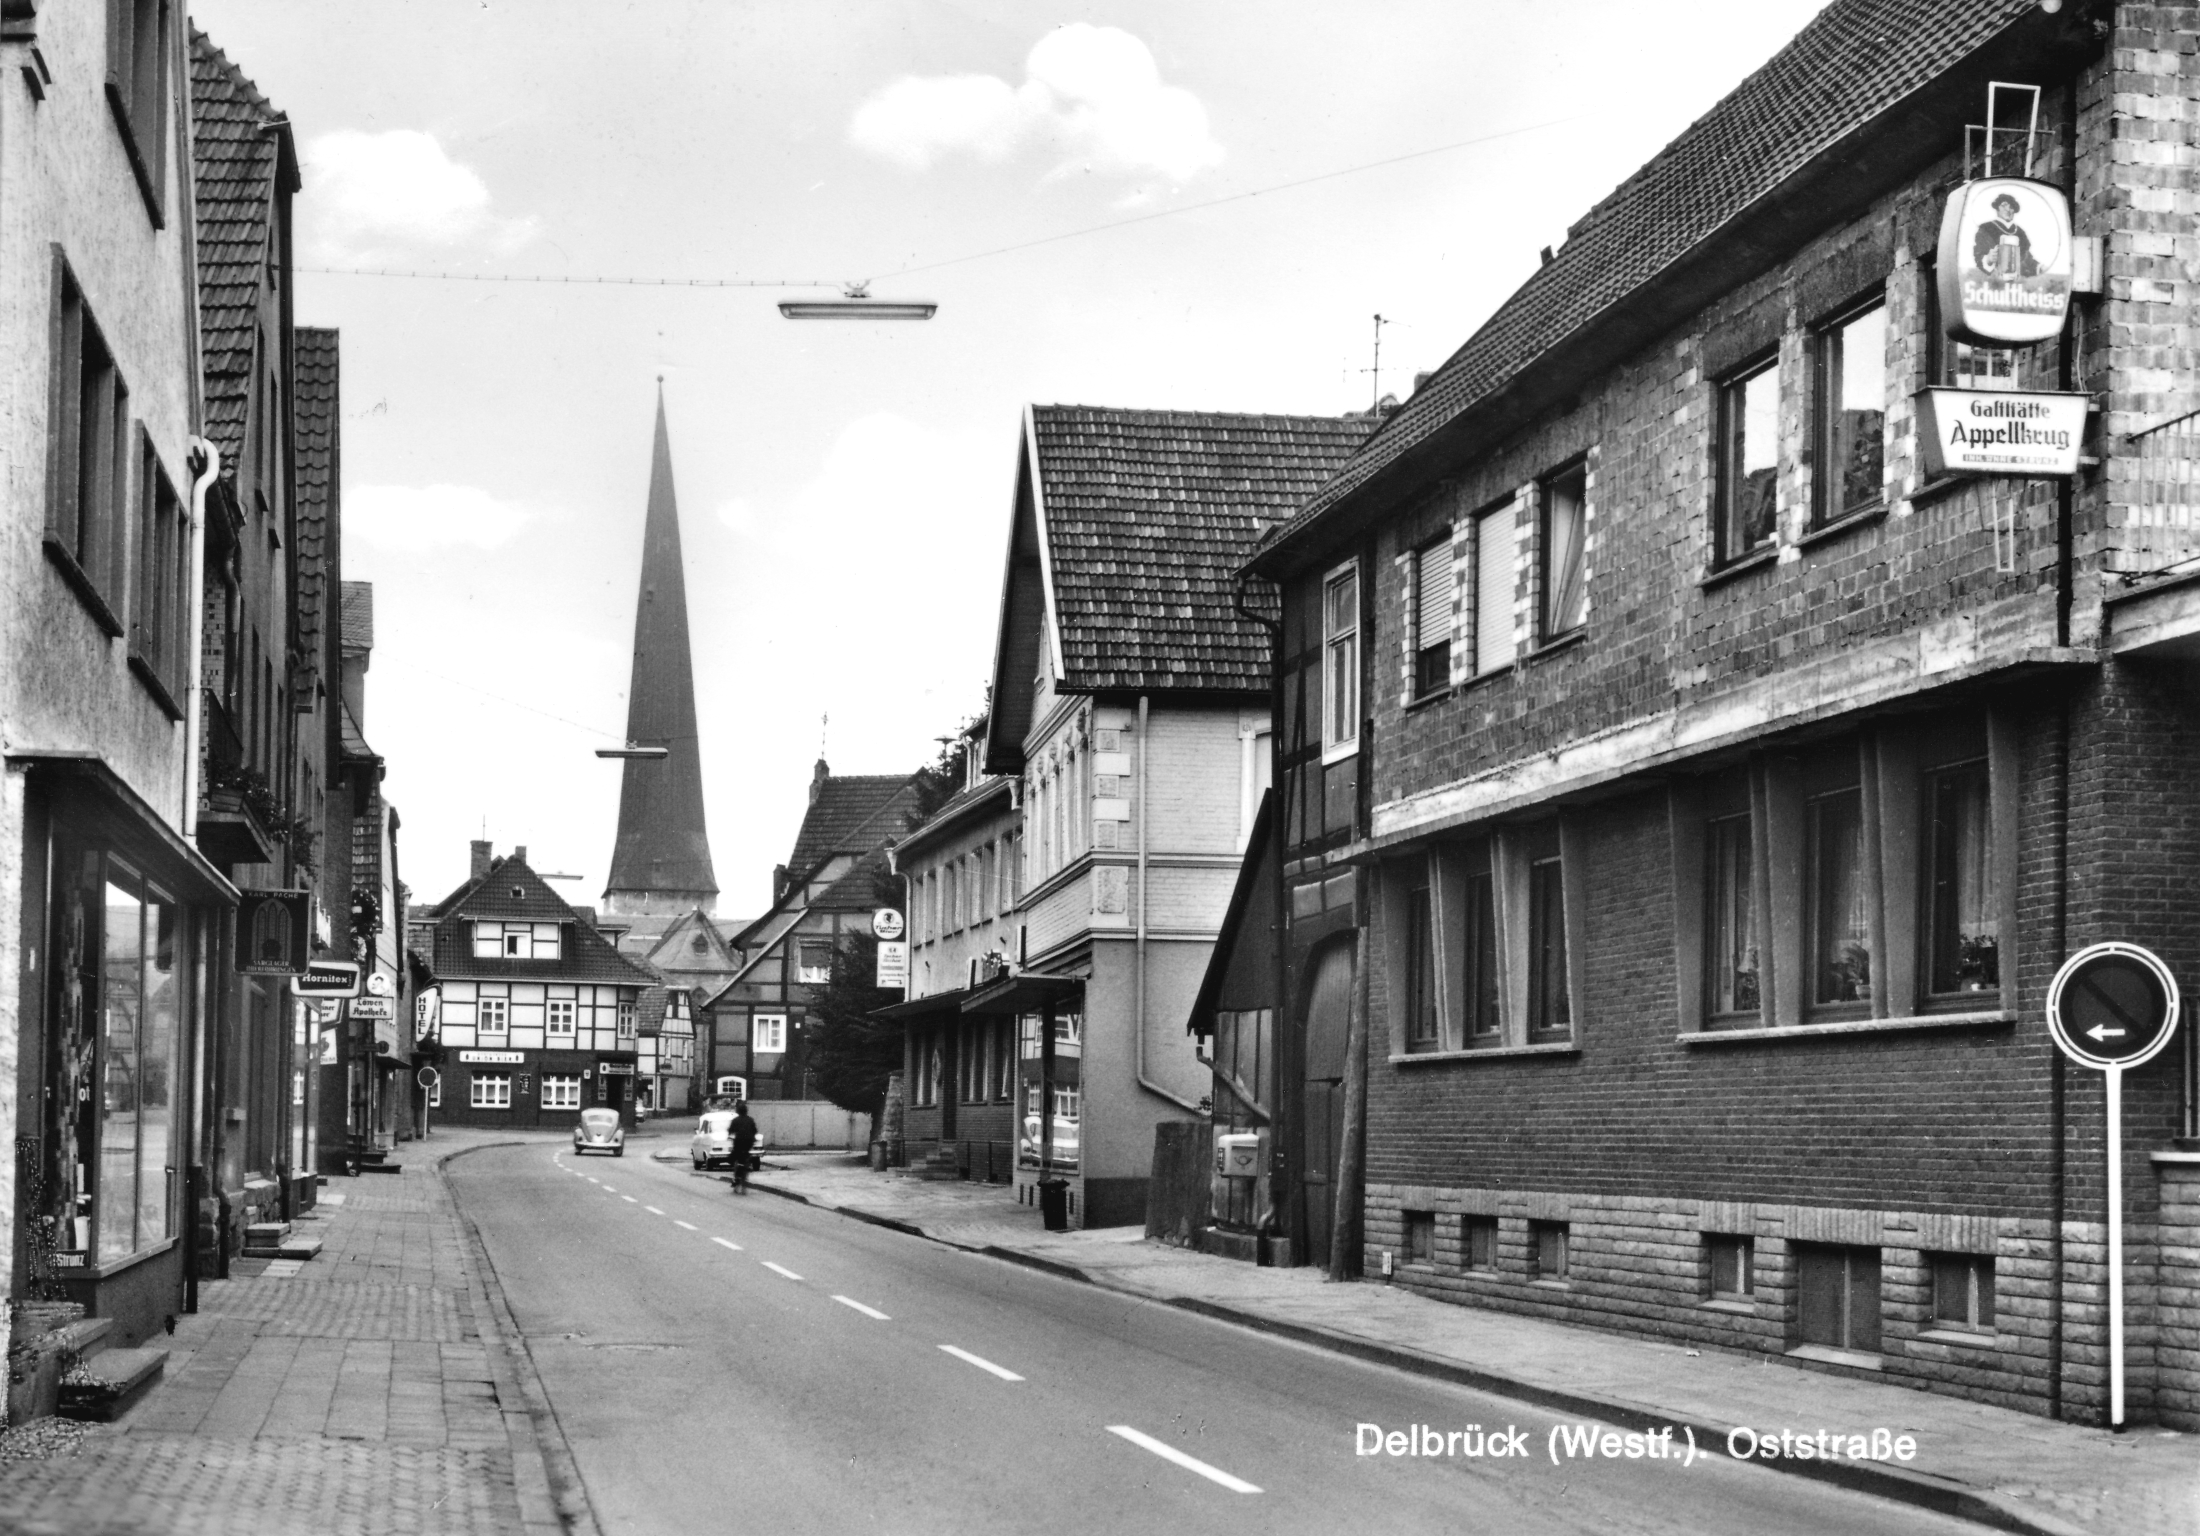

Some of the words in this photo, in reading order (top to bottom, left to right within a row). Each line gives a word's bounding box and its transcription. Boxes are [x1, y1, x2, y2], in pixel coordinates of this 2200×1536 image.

[1964, 281, 2065, 310] Schultheiss
[1950, 420, 2070, 451] Appellkrug
[302, 973, 348, 983] Hornitex
[417, 997, 427, 1036] HOTEL
